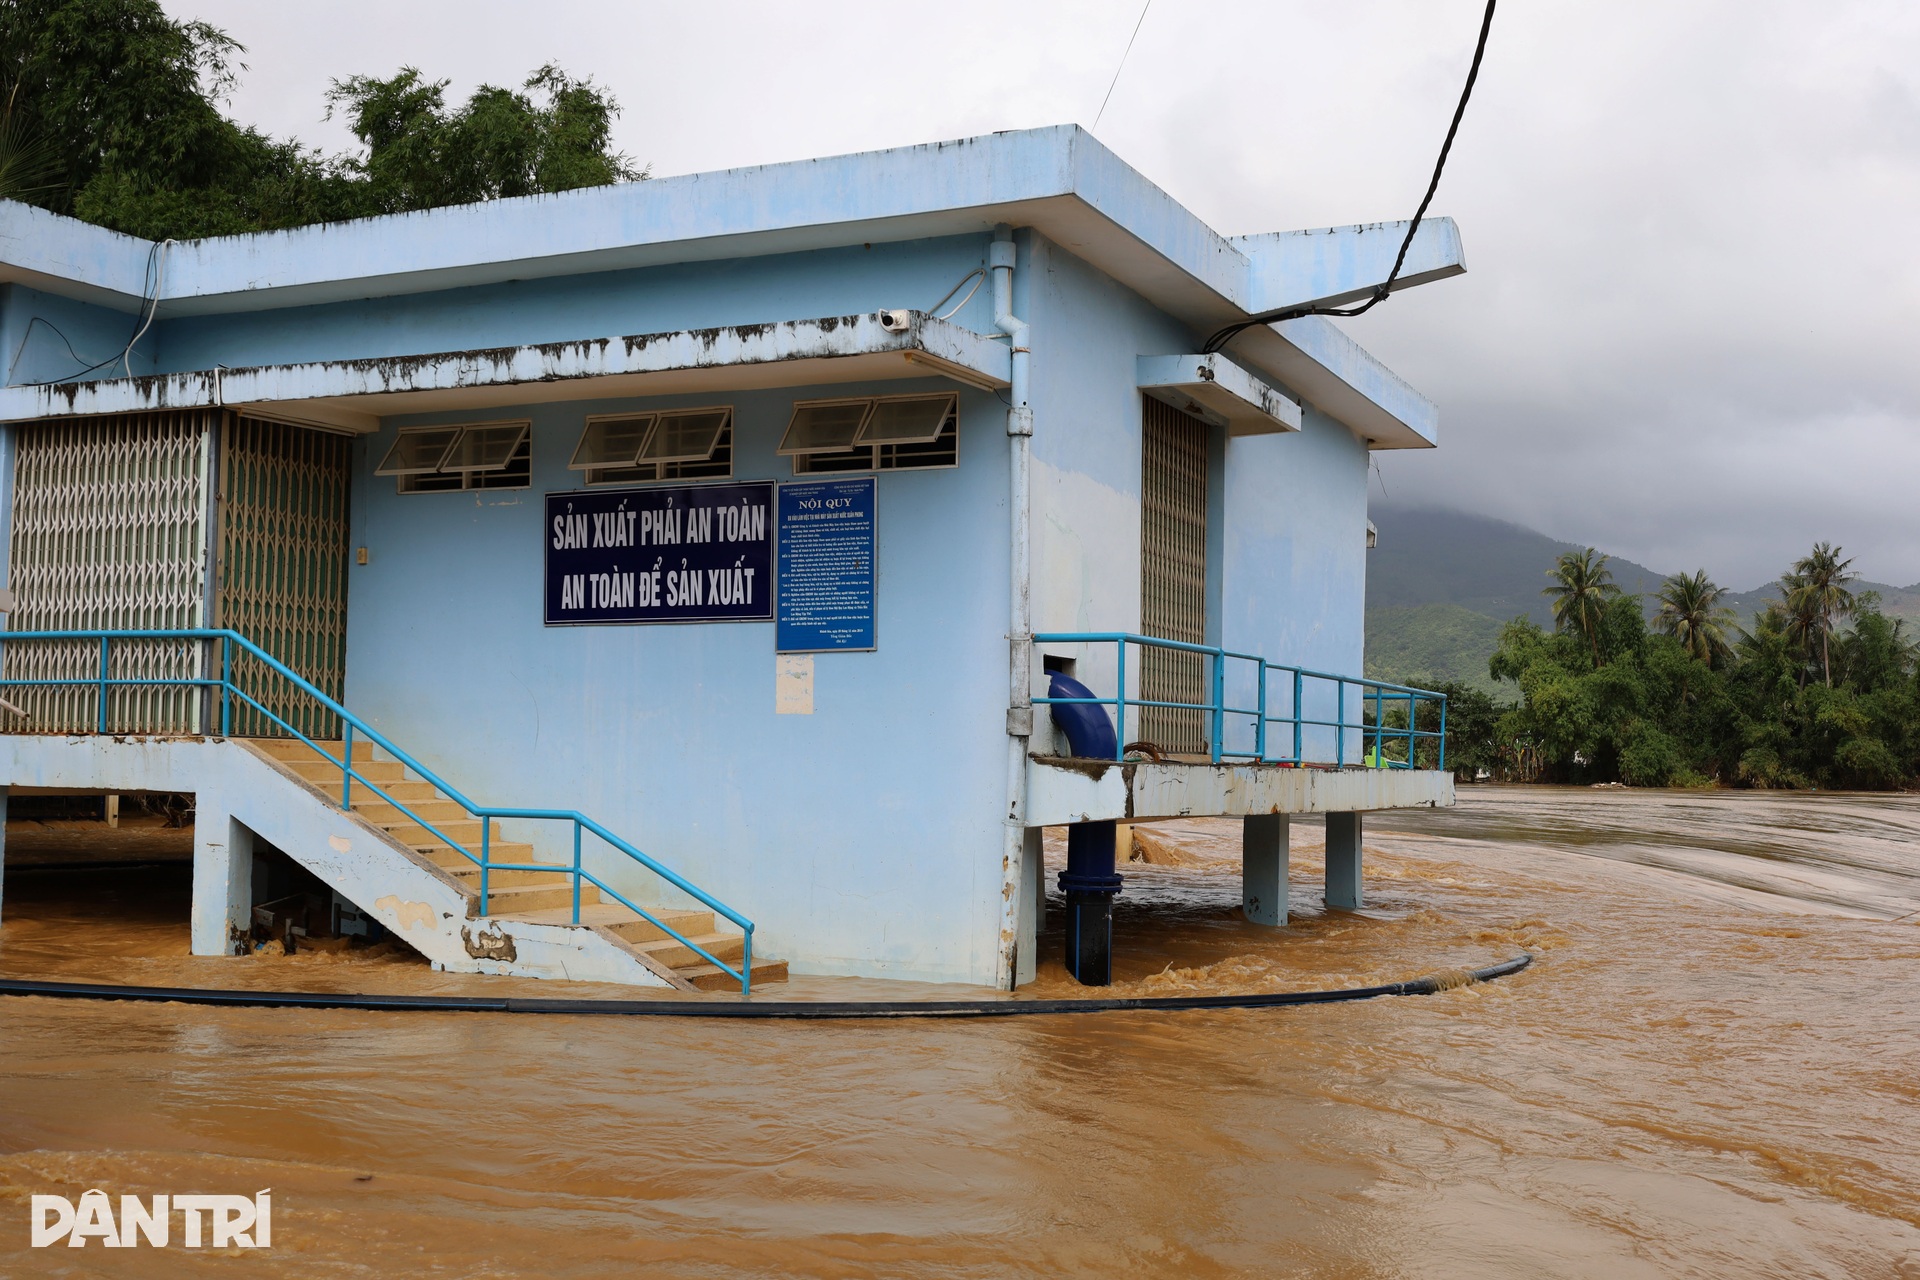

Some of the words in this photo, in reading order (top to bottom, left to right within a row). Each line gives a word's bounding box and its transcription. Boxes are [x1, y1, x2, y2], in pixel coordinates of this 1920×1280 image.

[553, 502, 588, 550] SẢN
[592, 498, 637, 548] XUẤT
[641, 496, 681, 546] PHẢI
[686, 507, 712, 544] AN
[716, 497, 765, 543] TOÀN
[798, 498, 822, 511] NỘI
[825, 498, 852, 509] QUY
[561, 574, 585, 610] AN
[589, 565, 635, 609] TOÀN
[639, 556, 663, 608] ĐỂ
[666, 557, 703, 607] SẢN
[707, 554, 755, 606] XUẤT
